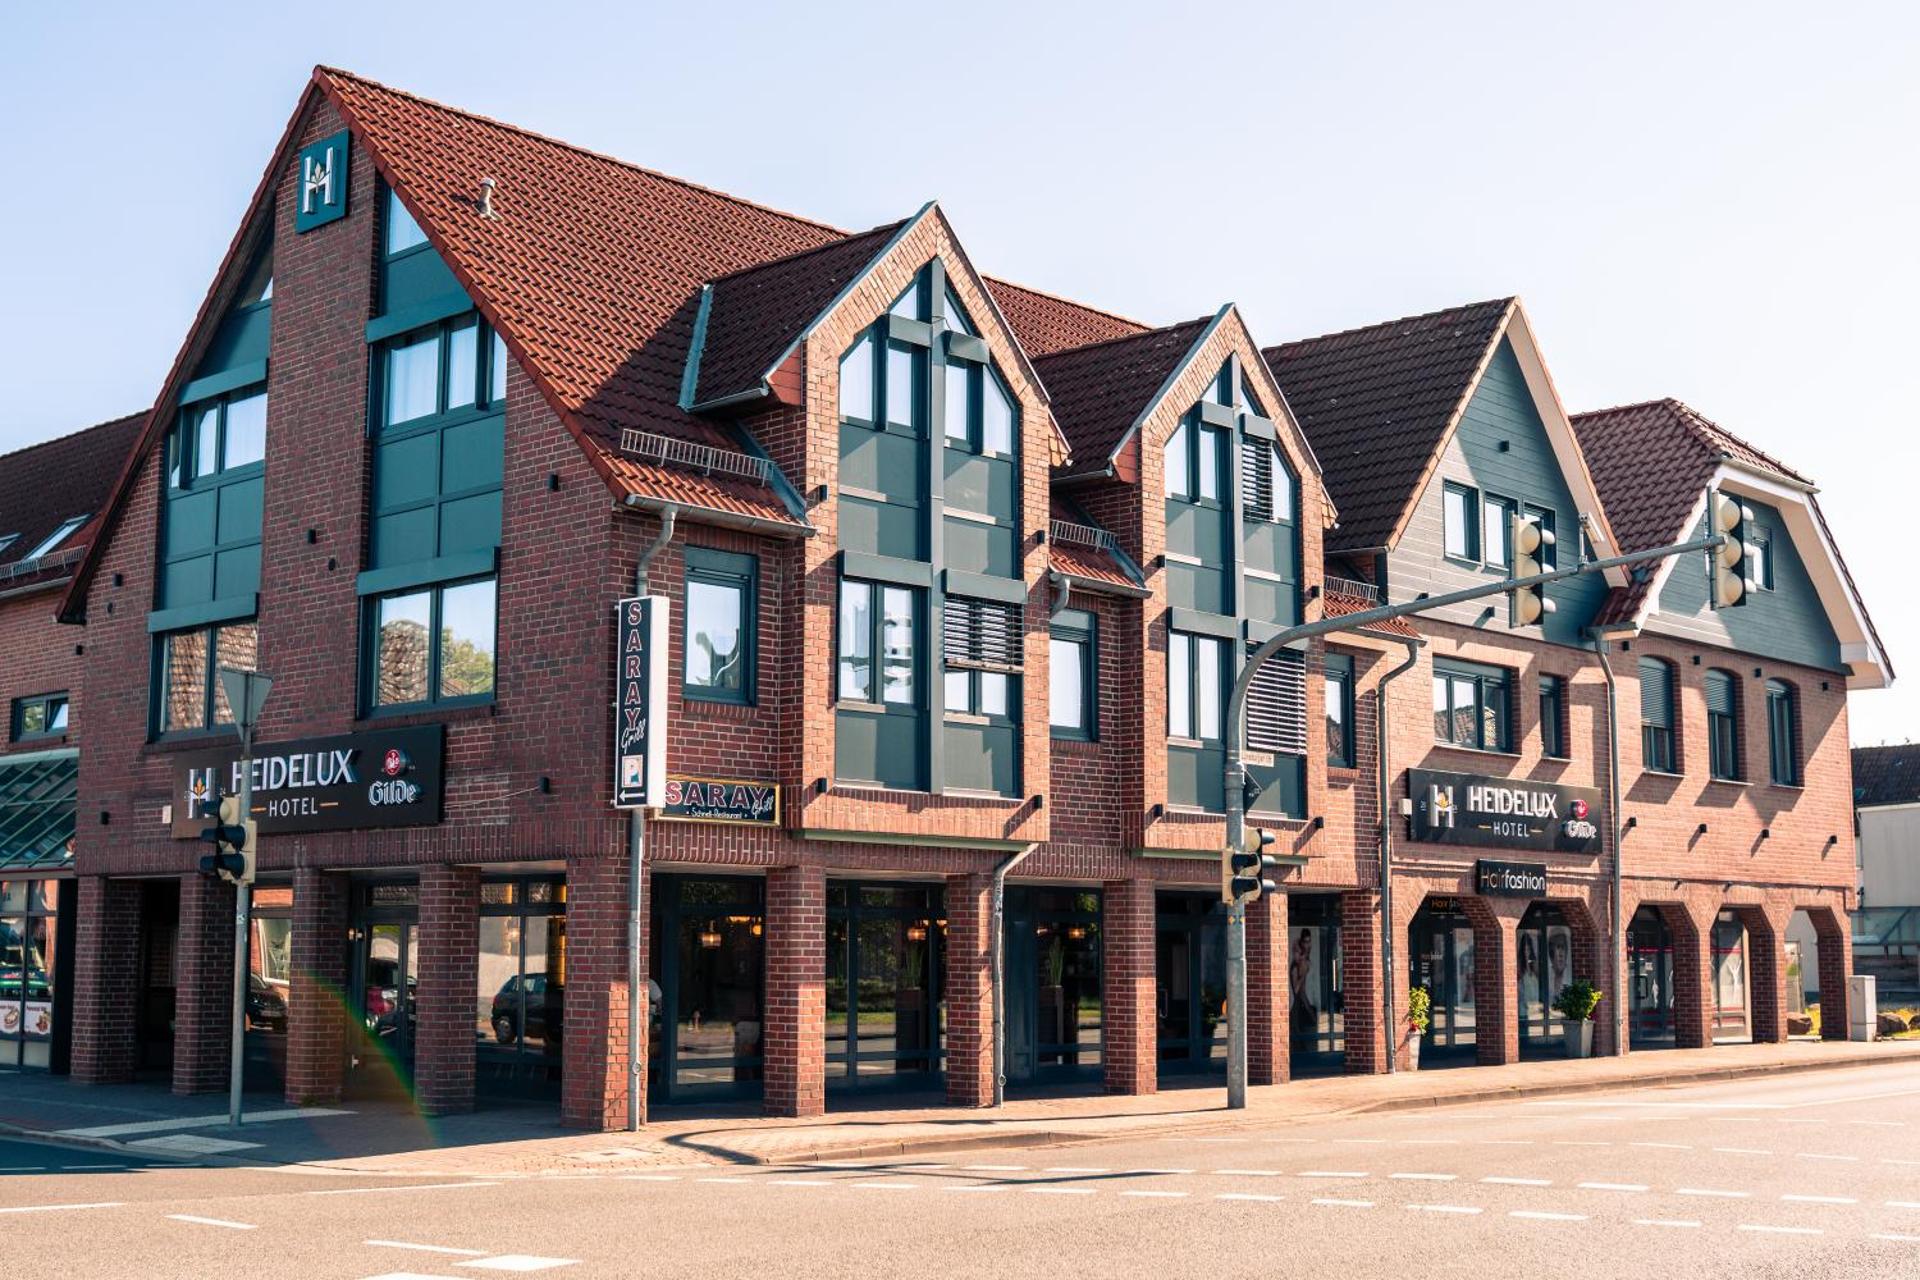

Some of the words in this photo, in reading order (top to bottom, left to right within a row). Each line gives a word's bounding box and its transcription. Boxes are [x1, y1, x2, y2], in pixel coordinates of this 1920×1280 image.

[302, 146, 335, 214] H
[624, 602, 642, 731] SARAY
[621, 718, 646, 754] Grill
[232, 749, 354, 793] HEIDELUX
[269, 798, 318, 817] HOTEL
[368, 780, 417, 807] Gilde
[666, 781, 769, 809] SARAY
[751, 795, 774, 820] Grill
[1467, 785, 1558, 819] HEIDELUX
[1493, 822, 1530, 838] HOTEL
